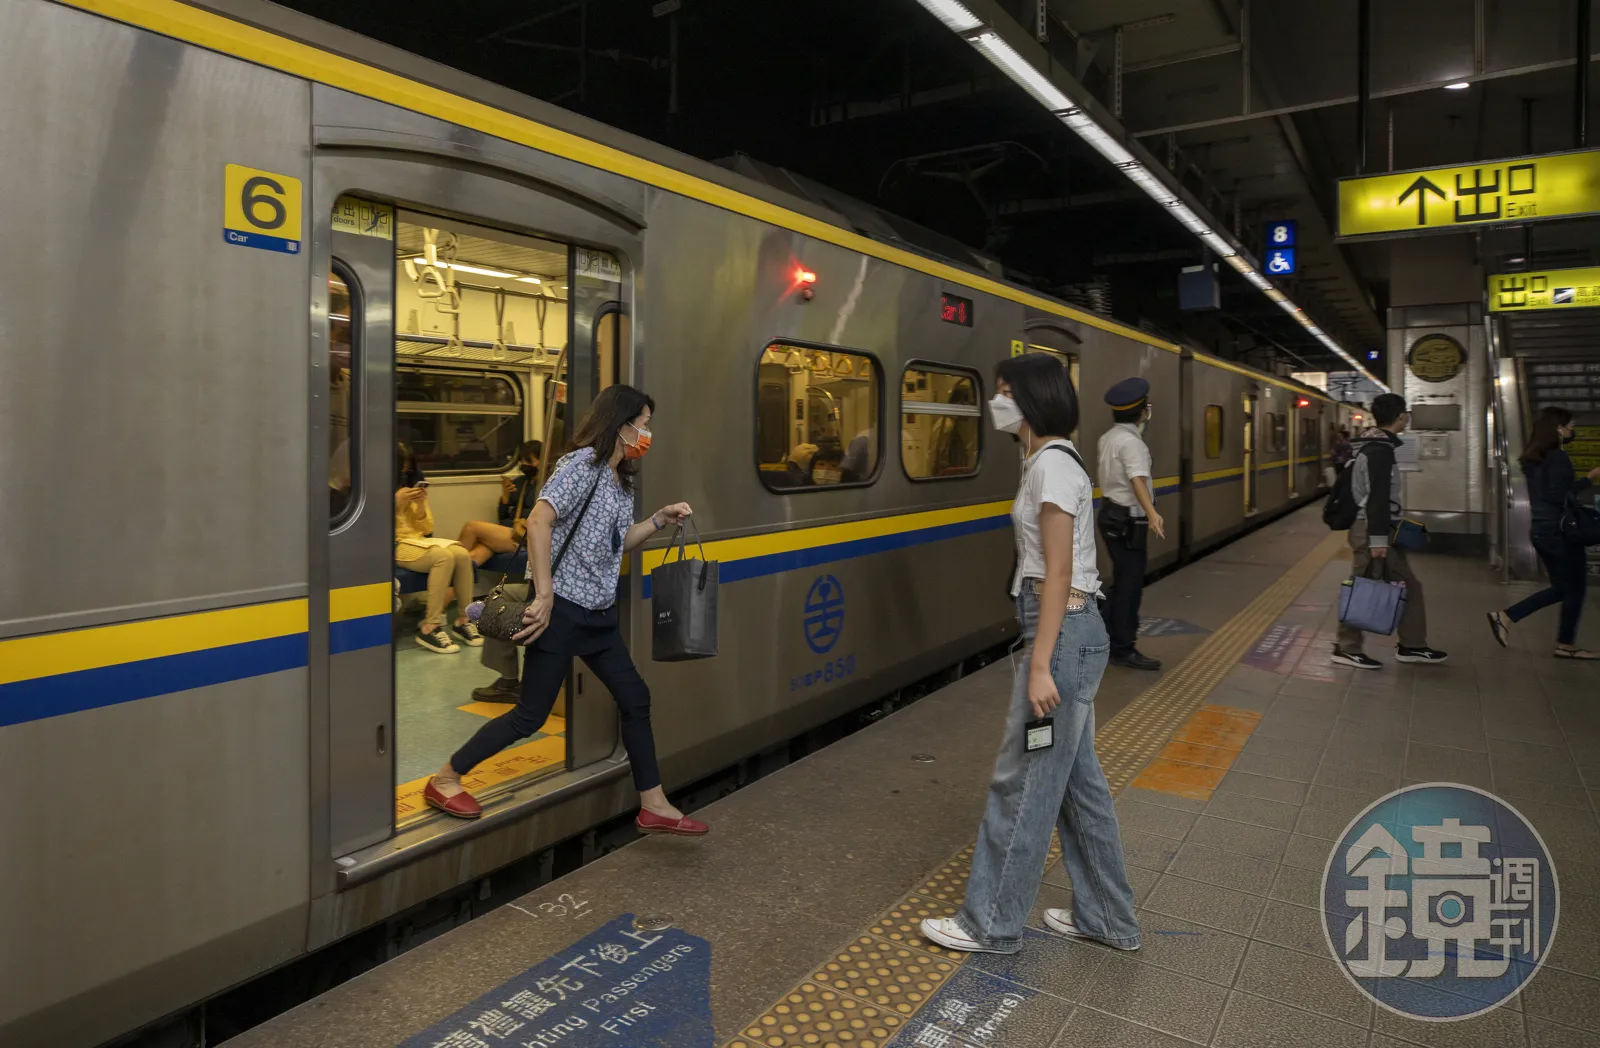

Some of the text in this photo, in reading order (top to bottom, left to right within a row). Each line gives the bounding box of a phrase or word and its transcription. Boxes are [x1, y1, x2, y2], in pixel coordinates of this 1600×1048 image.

[241, 176, 287, 230] 6
[1454, 163, 1536, 223] 出口
[333, 216, 355, 226] doors
[1506, 201, 1537, 218] Exit
[229, 232, 248, 243] Car
[1273, 226, 1288, 242] 8
[1498, 276, 1548, 308] 出口
[581, 943, 693, 1013] Passengers
[600, 999, 657, 1036] First
